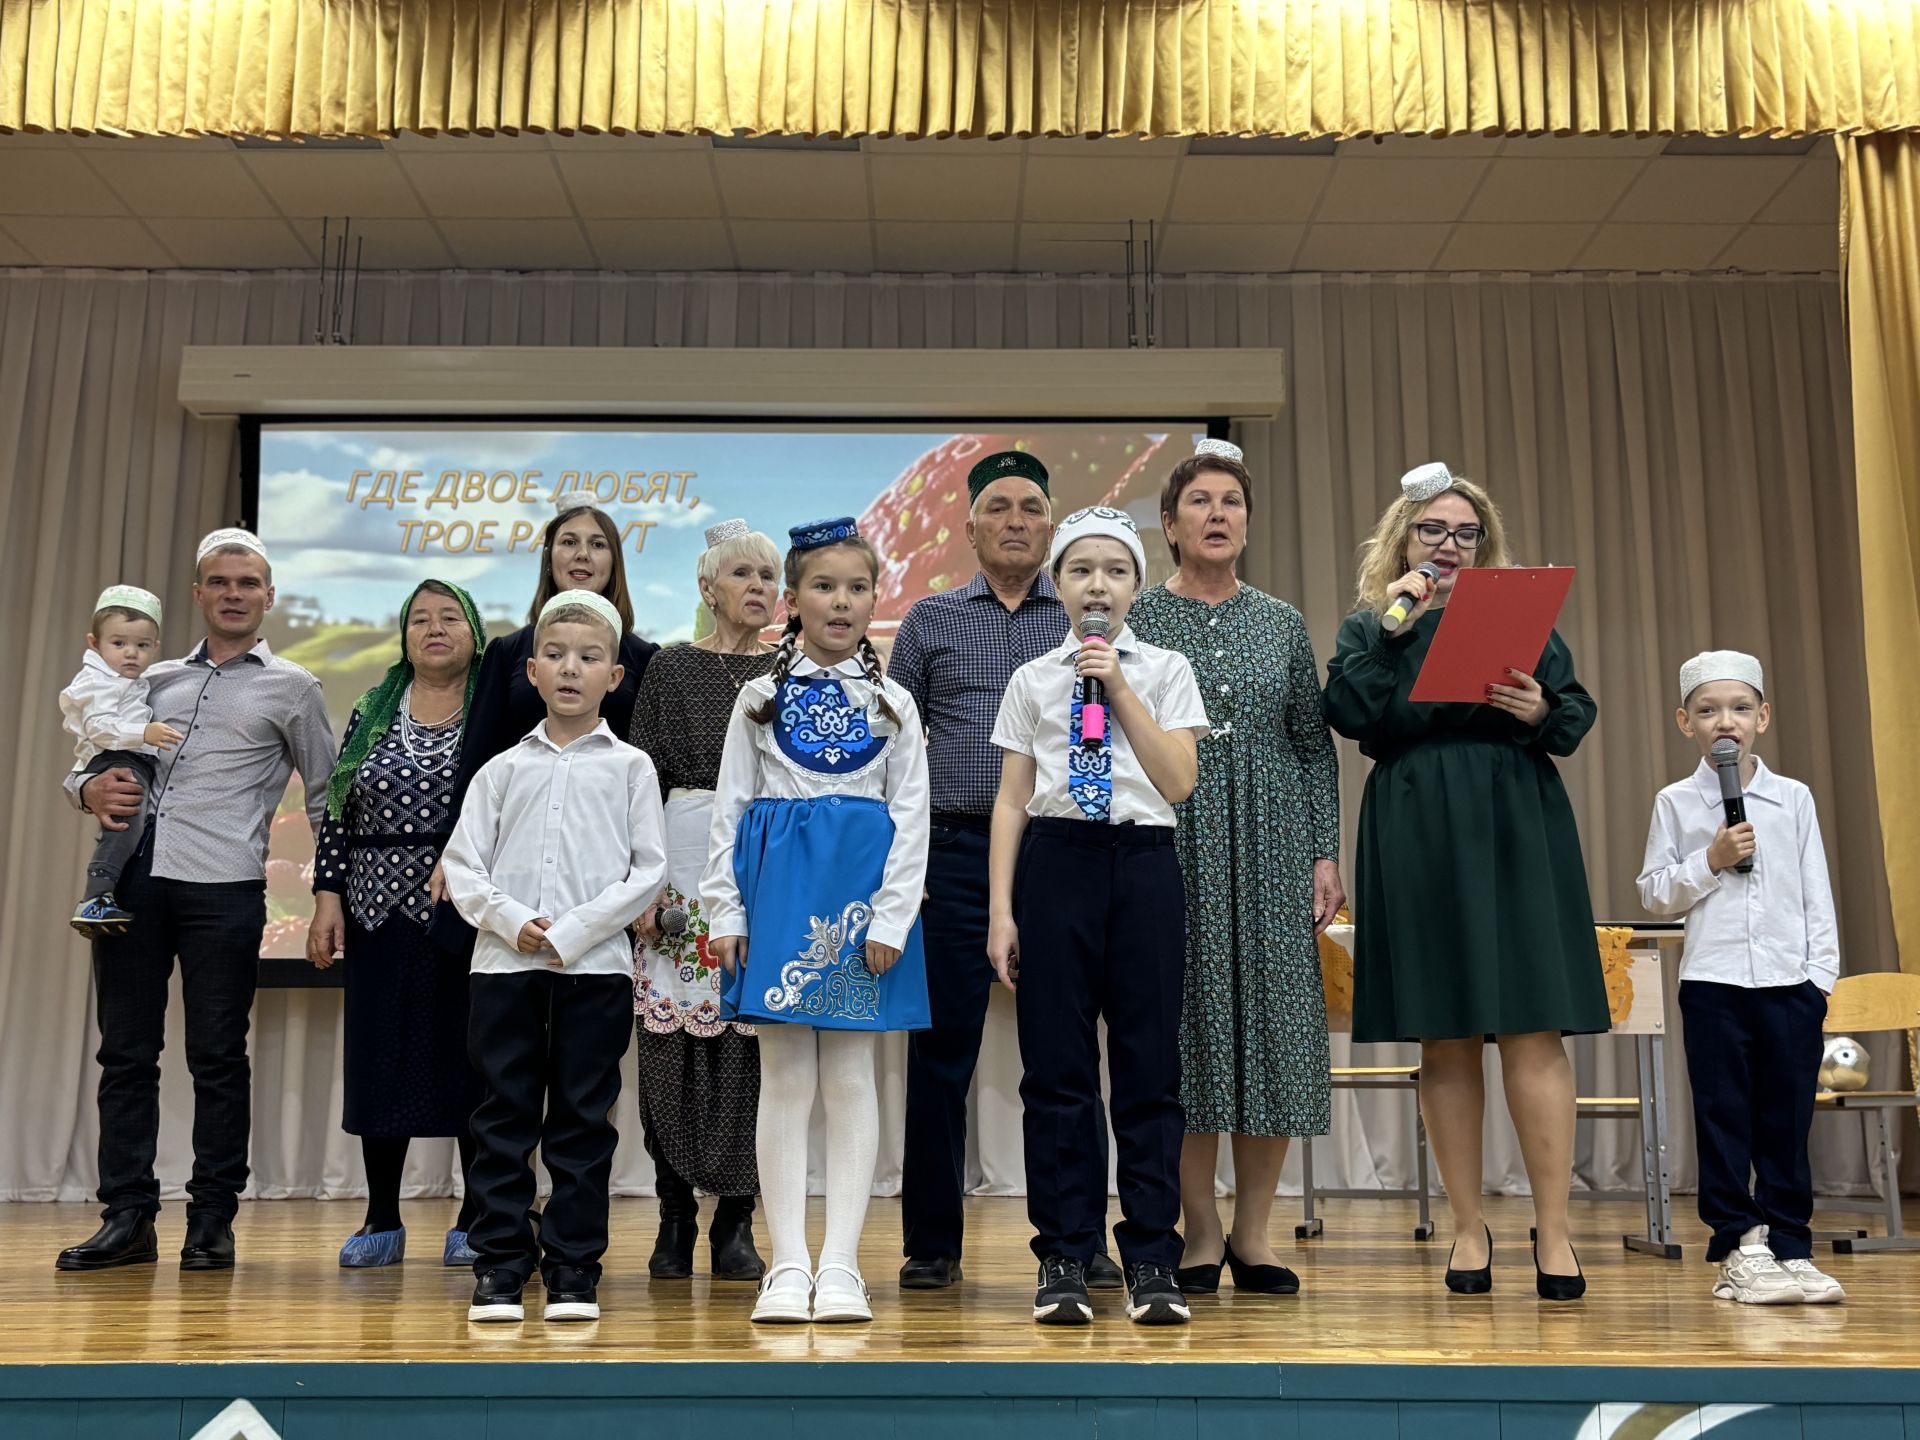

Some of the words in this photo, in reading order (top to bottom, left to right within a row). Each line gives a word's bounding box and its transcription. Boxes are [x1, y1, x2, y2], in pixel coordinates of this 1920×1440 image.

[346, 470, 423, 510] ГДЕ
[425, 470, 542, 510] ДВОЕ
[547, 470, 699, 510] ЛЮБЯТ,
[398, 520, 499, 553] ТРОЕ
